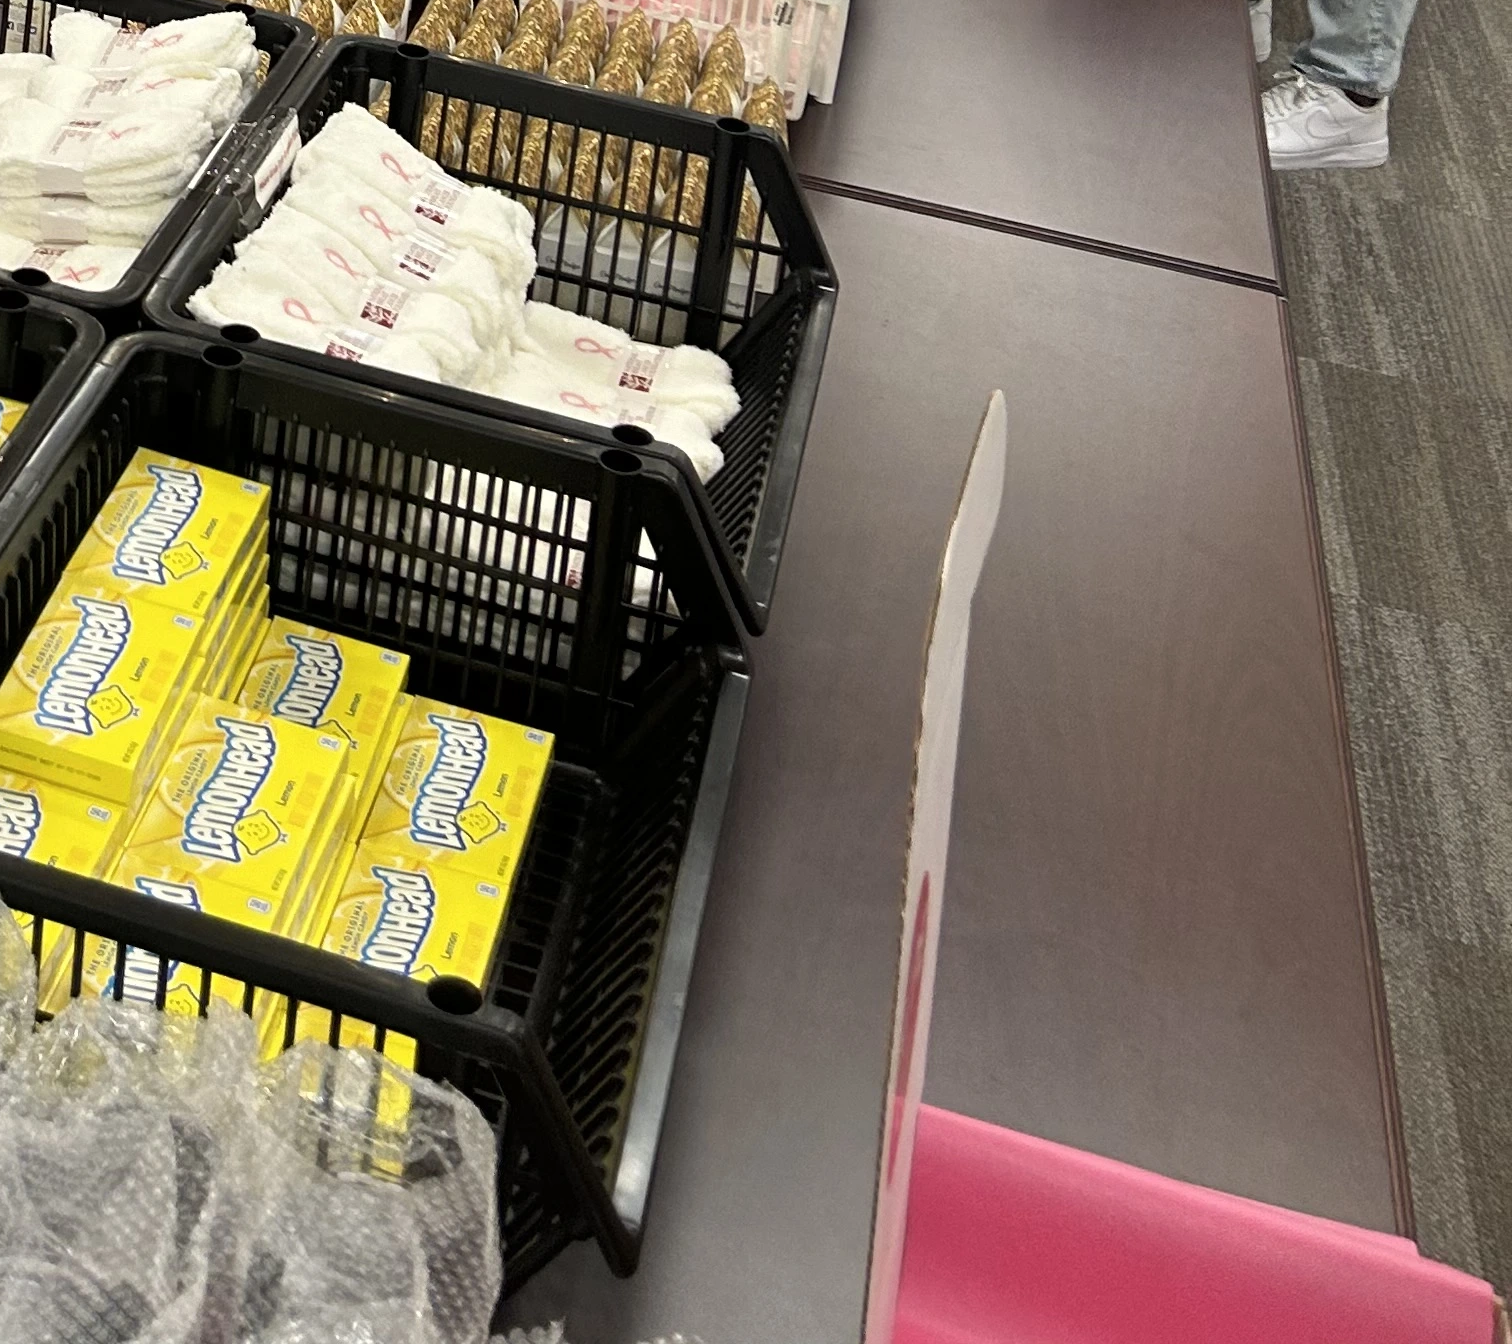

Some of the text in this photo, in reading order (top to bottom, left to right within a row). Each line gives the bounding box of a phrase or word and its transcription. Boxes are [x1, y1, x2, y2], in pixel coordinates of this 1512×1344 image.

[200, 518, 219, 540] Lemon
[36, 625, 61, 663] ORIGINAL
[130, 656, 149, 682] Lemon
[257, 664, 279, 701] ORIGINAL
[345, 693, 362, 717] Lemon
[182, 748, 206, 788] ORIGINAL
[276, 780, 296, 807] Lemon
[493, 773, 509, 798] Lemon
[343, 900, 365, 944] ORIGINAL
[441, 931, 460, 960] Lemon
